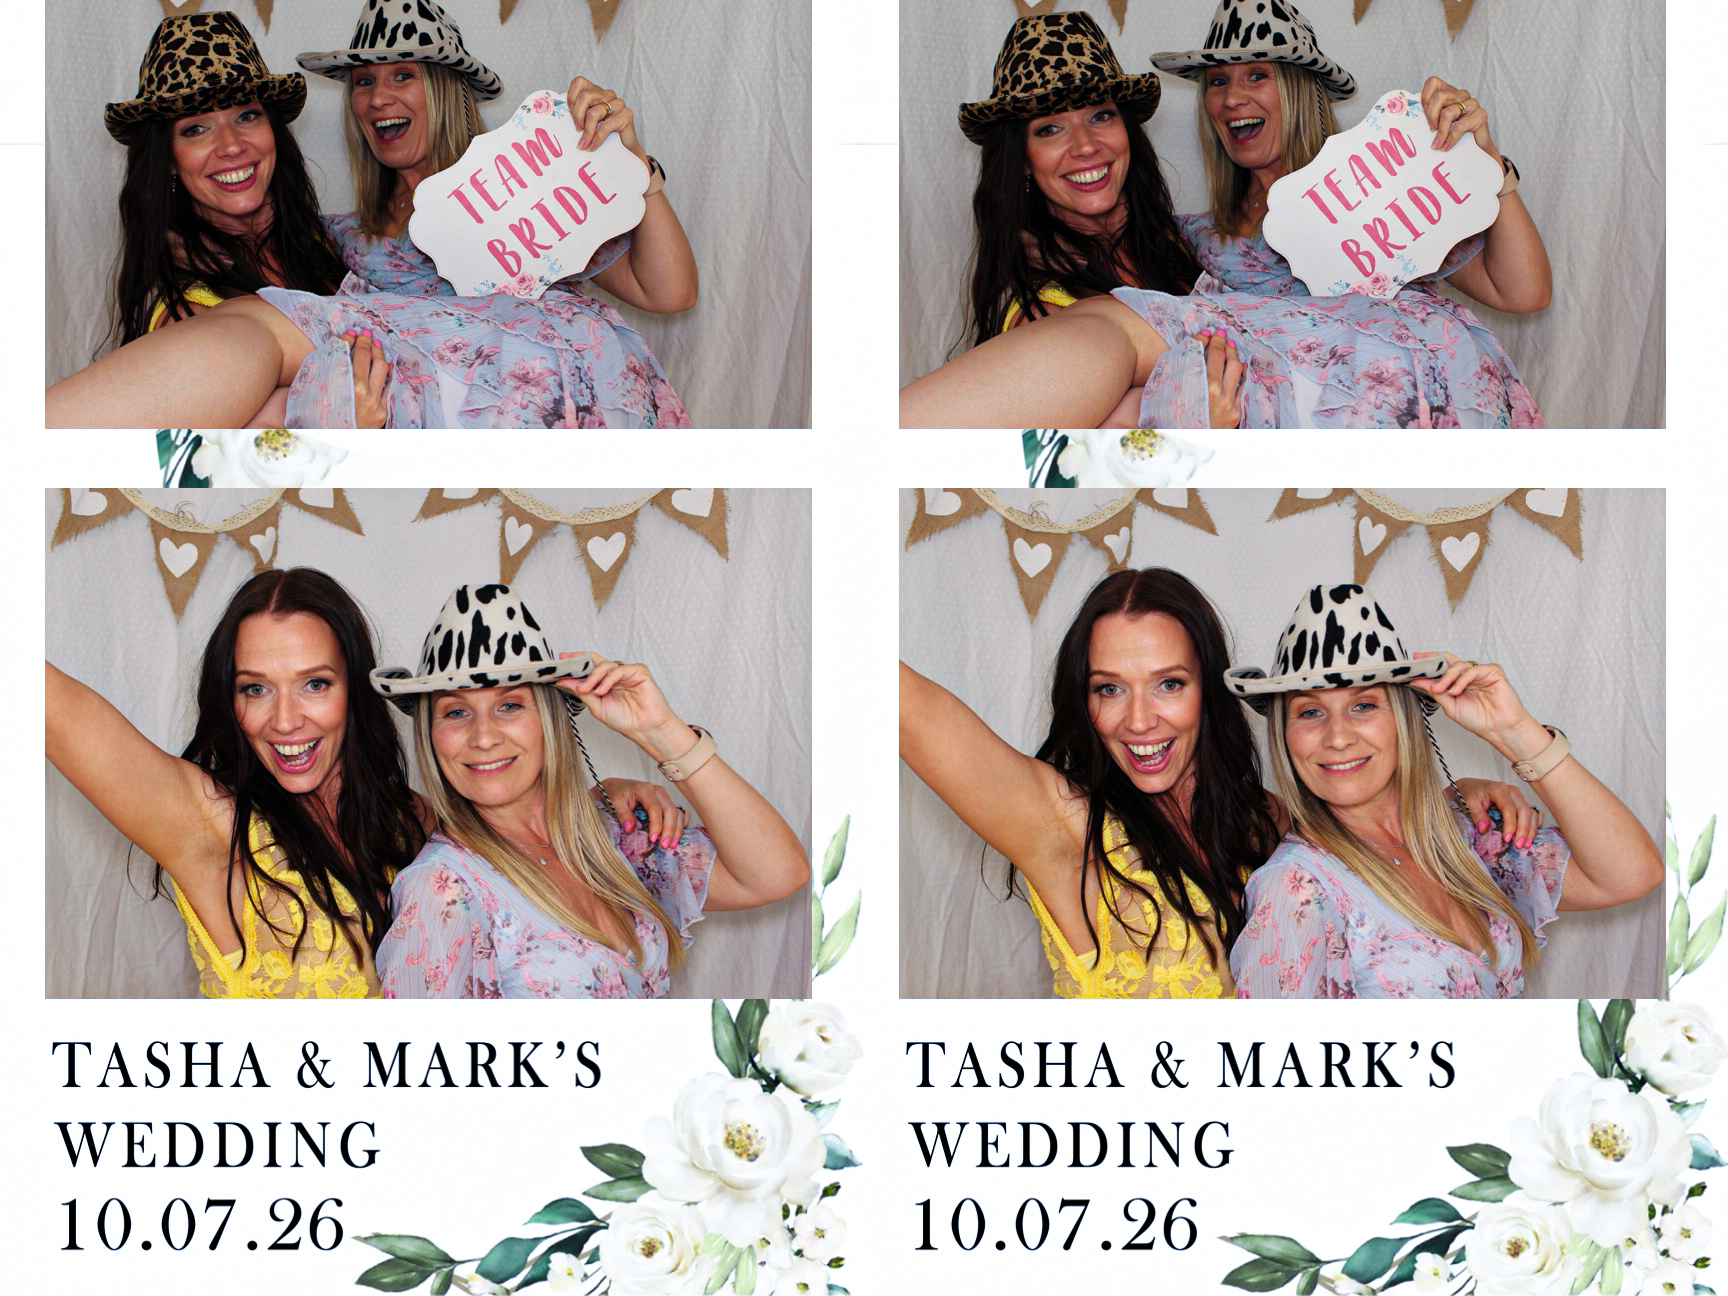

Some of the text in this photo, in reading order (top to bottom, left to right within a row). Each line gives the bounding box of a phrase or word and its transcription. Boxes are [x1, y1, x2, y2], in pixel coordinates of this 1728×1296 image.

[447, 127, 563, 224] TEAM
[487, 161, 617, 278] BRIDE
[1301, 127, 1417, 224] TEAM
[1341, 161, 1471, 278] BRIDE
